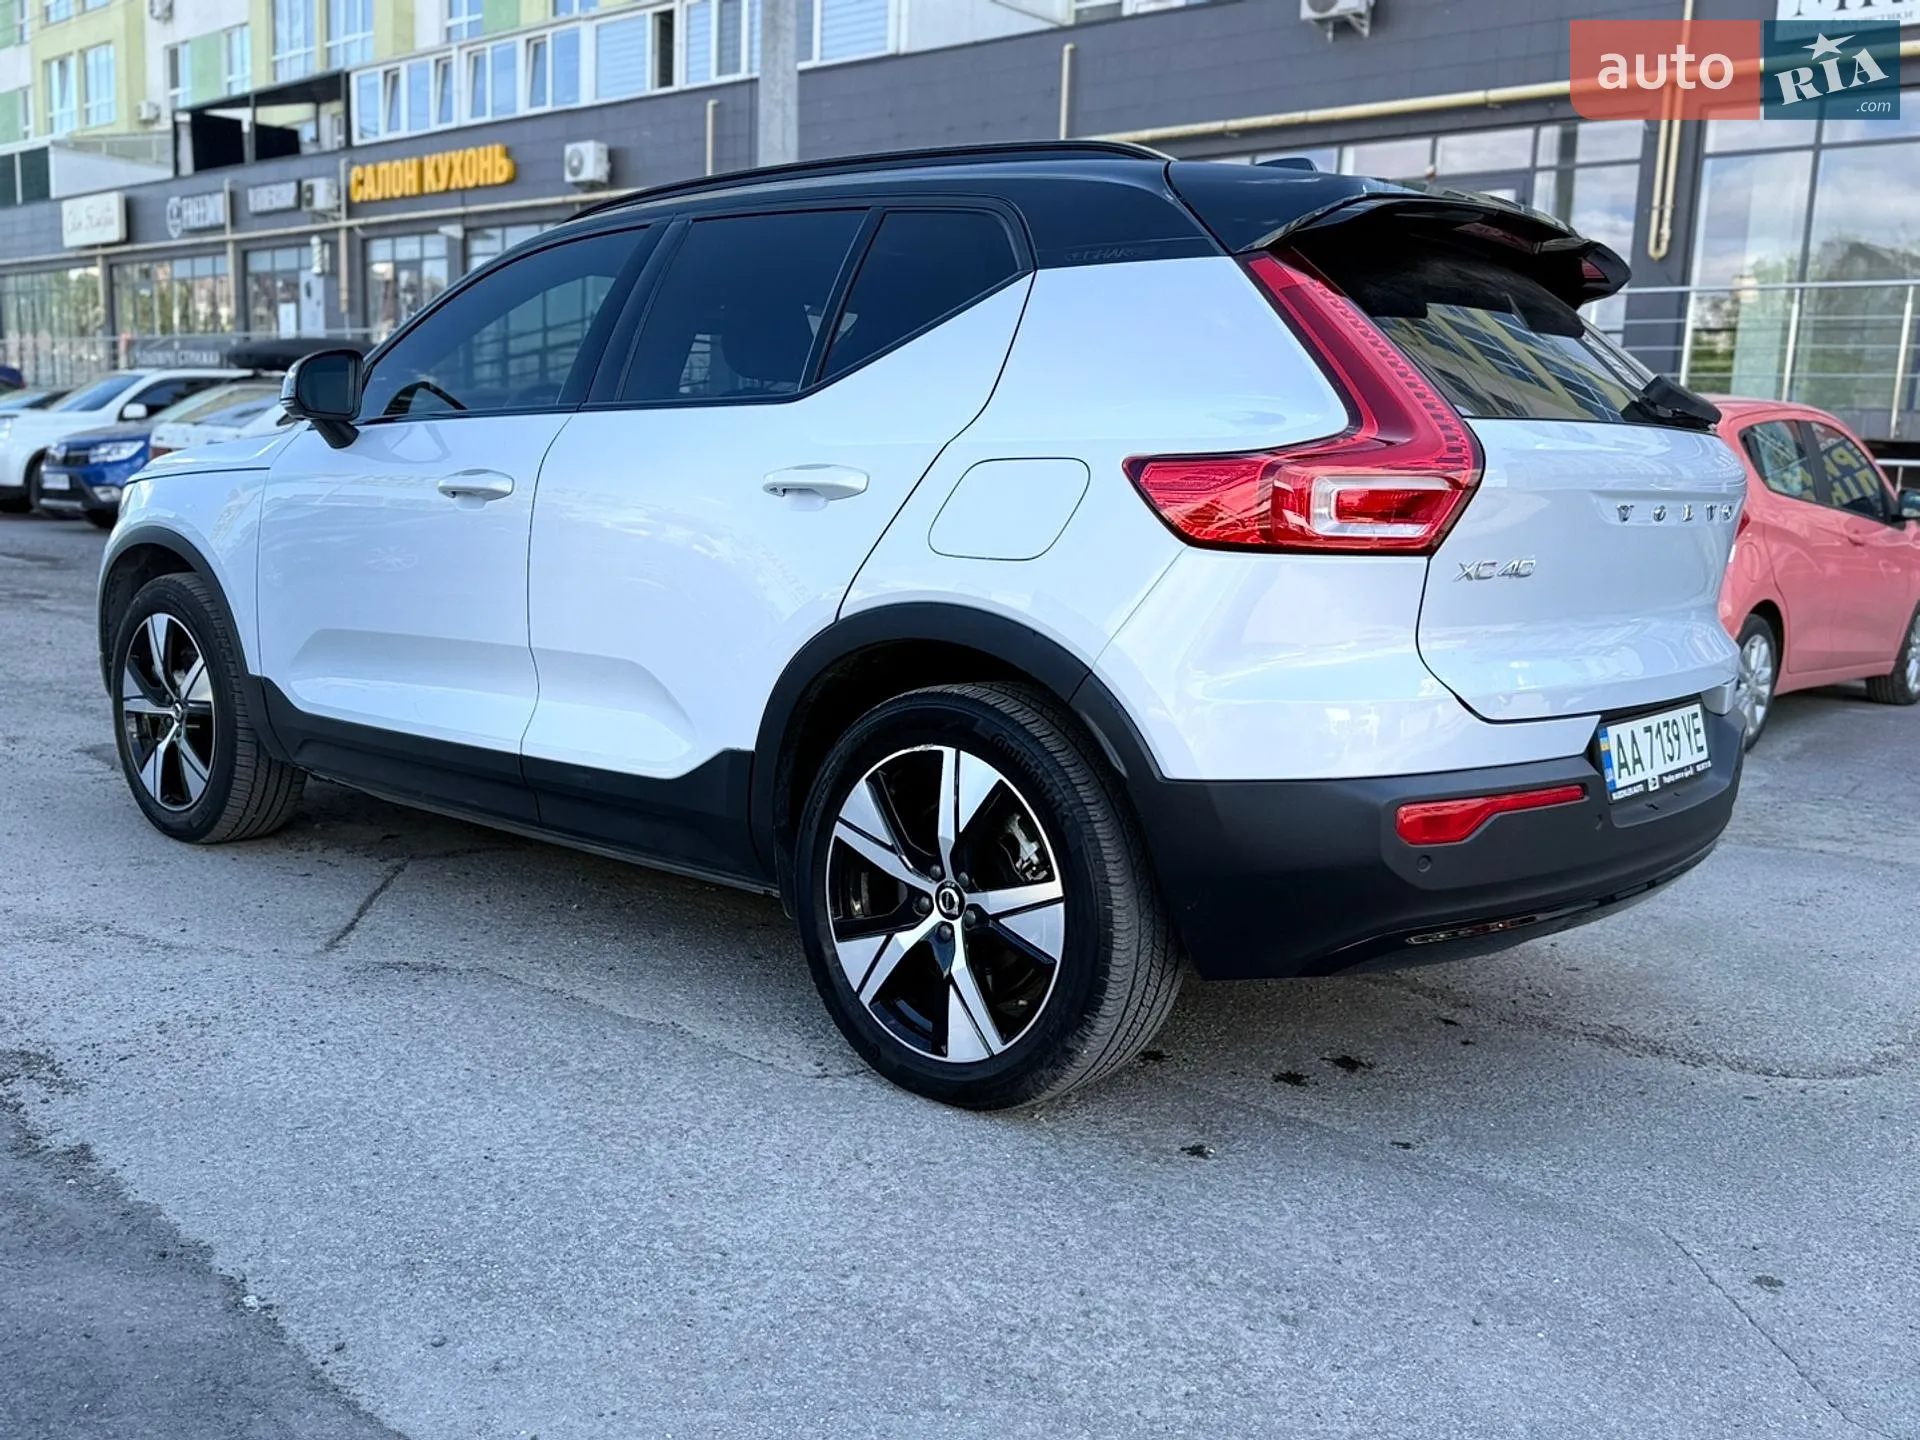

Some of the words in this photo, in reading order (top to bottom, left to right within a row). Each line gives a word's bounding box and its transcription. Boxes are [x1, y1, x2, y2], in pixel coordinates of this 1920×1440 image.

[350, 158, 423, 203] САЛОН
[423, 143, 516, 193] КУХОНЬ
[1616, 503, 1732, 523] VOLVO
[1616, 729, 1645, 780] AA
[1643, 718, 1681, 770] 7139
[1681, 711, 1705, 756] YE
